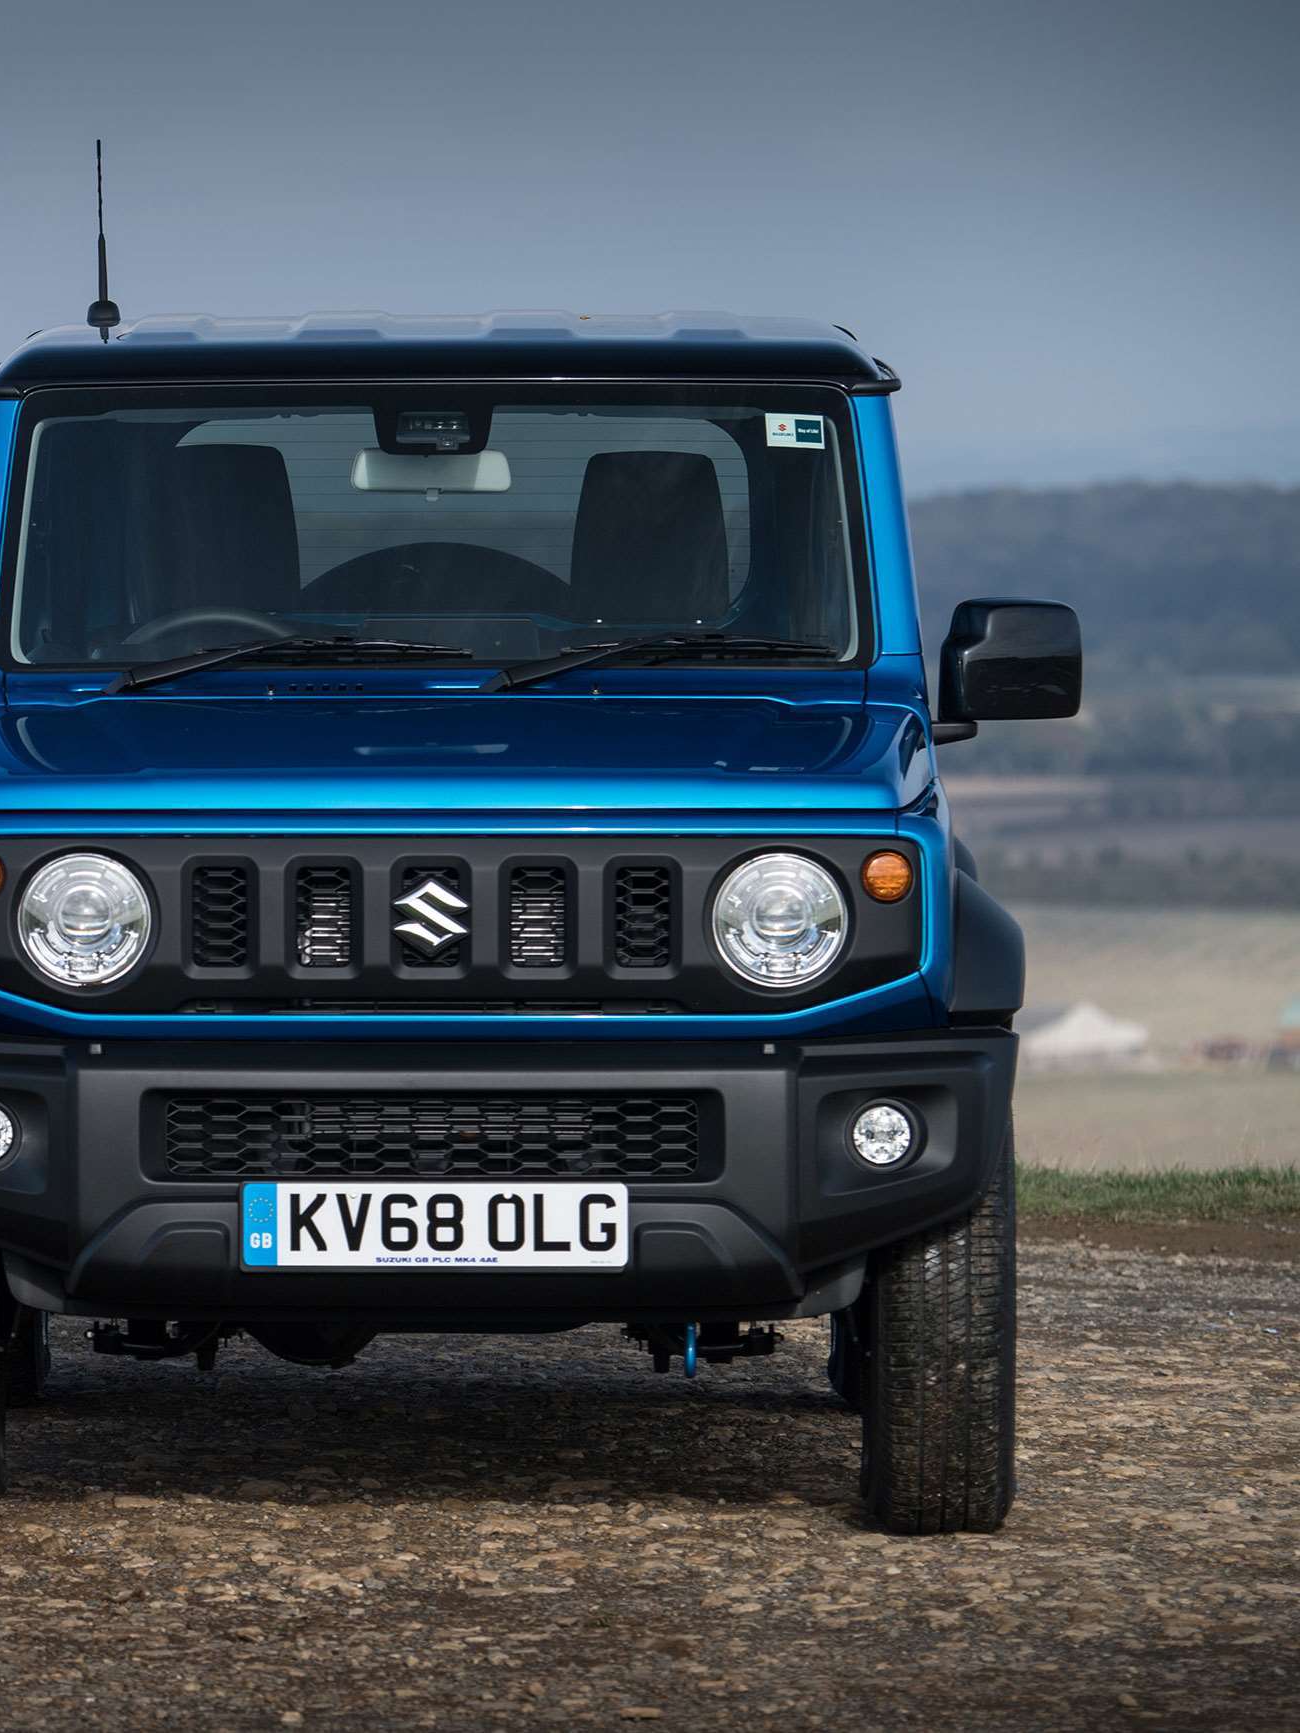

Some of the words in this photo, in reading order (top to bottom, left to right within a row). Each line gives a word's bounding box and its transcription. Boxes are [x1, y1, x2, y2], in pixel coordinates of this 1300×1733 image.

[290, 1193, 464, 1252] KV68
[487, 1193, 617, 1252] OLG
[249, 1232, 273, 1249] GB
[375, 1256, 412, 1264] SUZUKI
[415, 1256, 429, 1264] GB
[432, 1256, 452, 1264] PLC
[455, 1256, 477, 1264] MK4
[479, 1256, 499, 1264] 4AE
